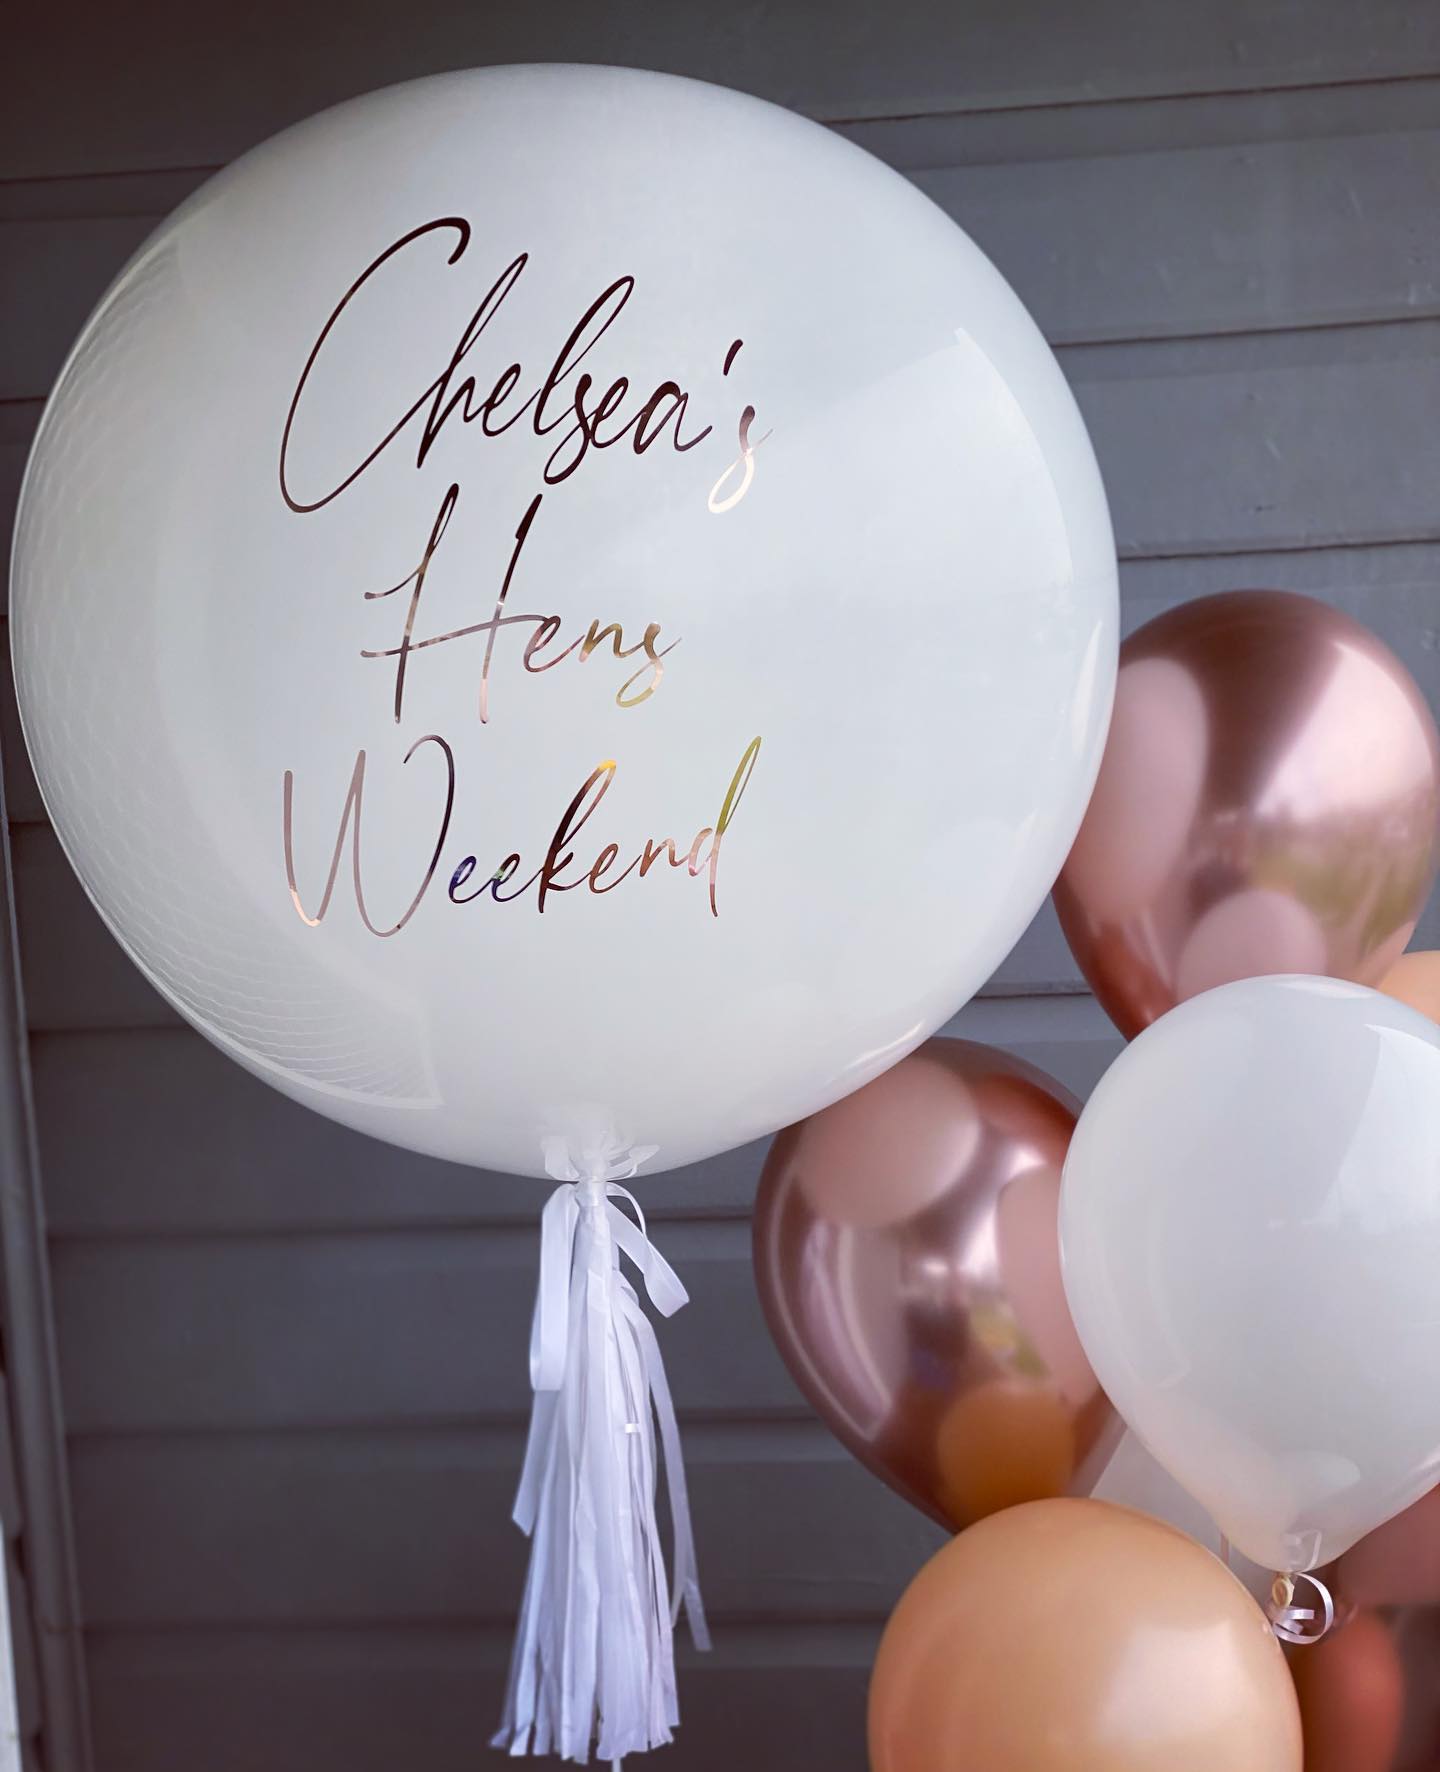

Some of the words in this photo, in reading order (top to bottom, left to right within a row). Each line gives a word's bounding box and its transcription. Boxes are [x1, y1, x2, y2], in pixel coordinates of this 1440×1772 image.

[279, 217, 774, 513] Chelsea's
[360, 483, 682, 724] Hens
[283, 734, 762, 938] Weekend
